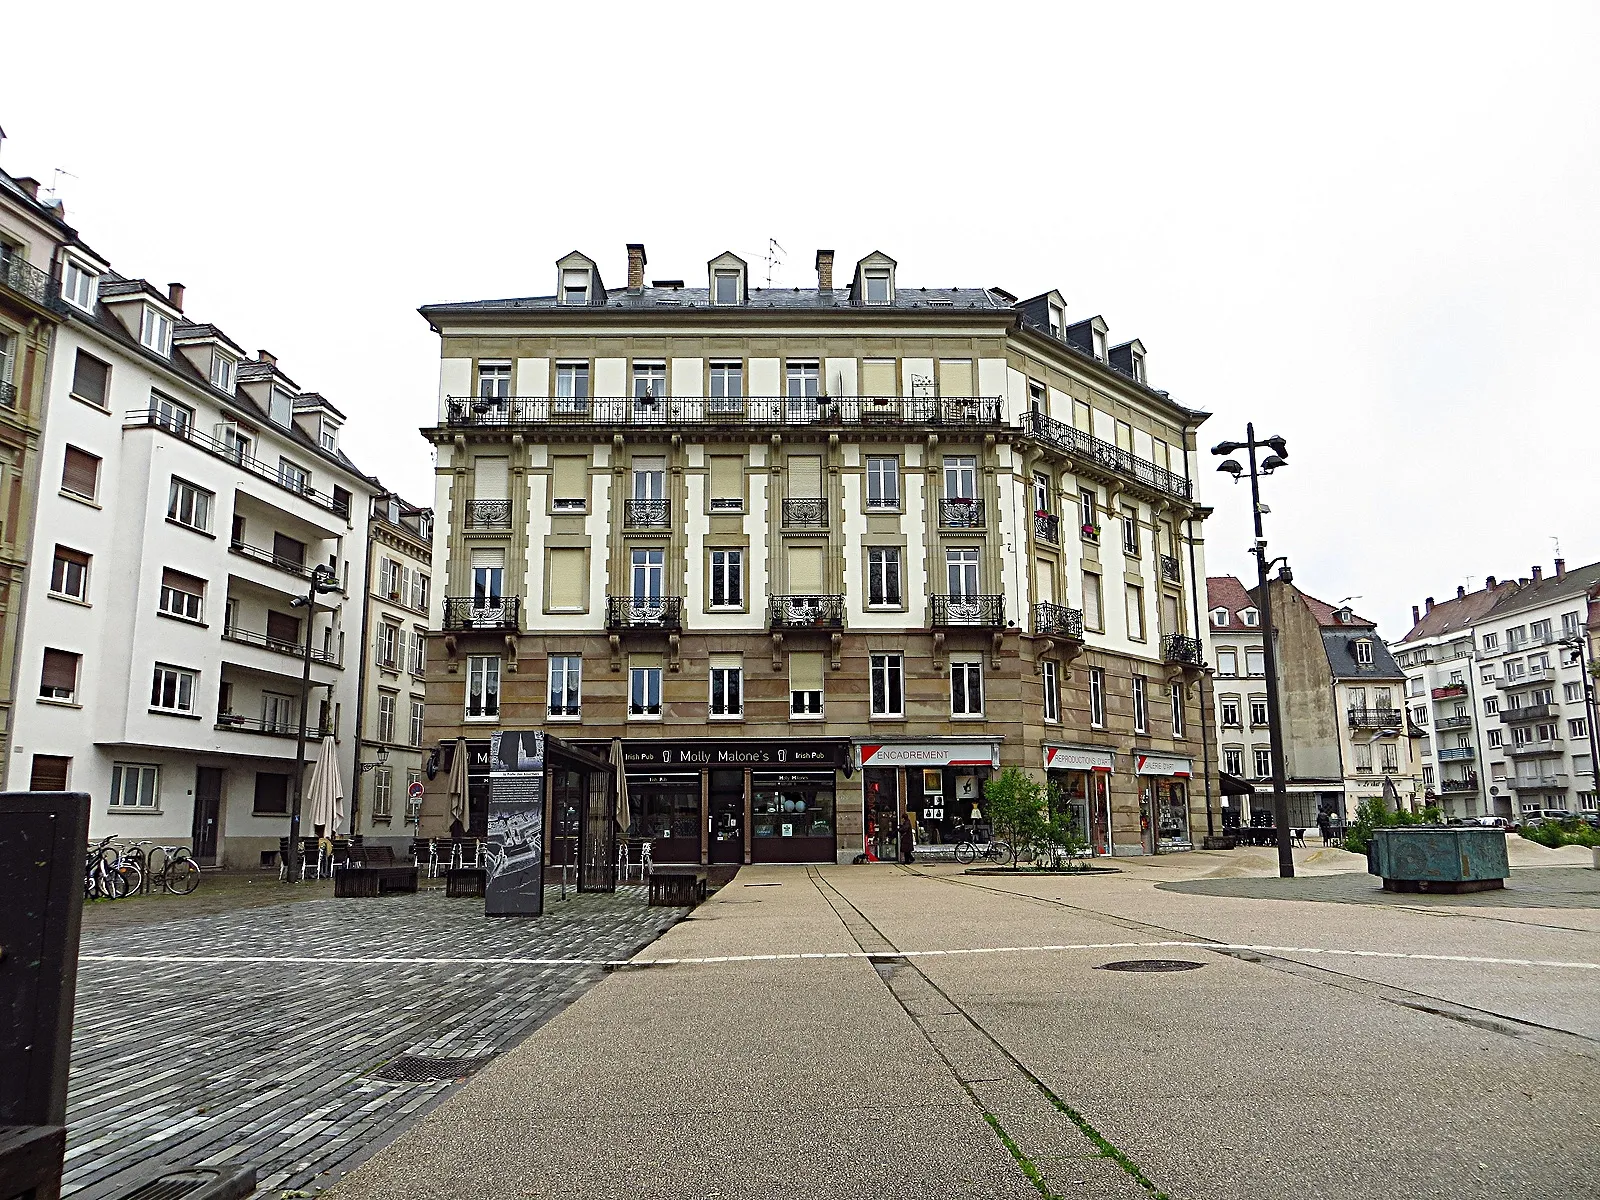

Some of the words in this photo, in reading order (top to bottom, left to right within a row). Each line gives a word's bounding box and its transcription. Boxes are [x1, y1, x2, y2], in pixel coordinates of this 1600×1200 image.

[680, 750, 711, 764] Molly
[718, 750, 770, 762] Malone's
[795, 752, 811, 760] Irish
[811, 752, 825, 760] Pub
[877, 750, 949, 760] ENCADREMENT
[1055, 754, 1096, 765] REPRODUCTIONS
